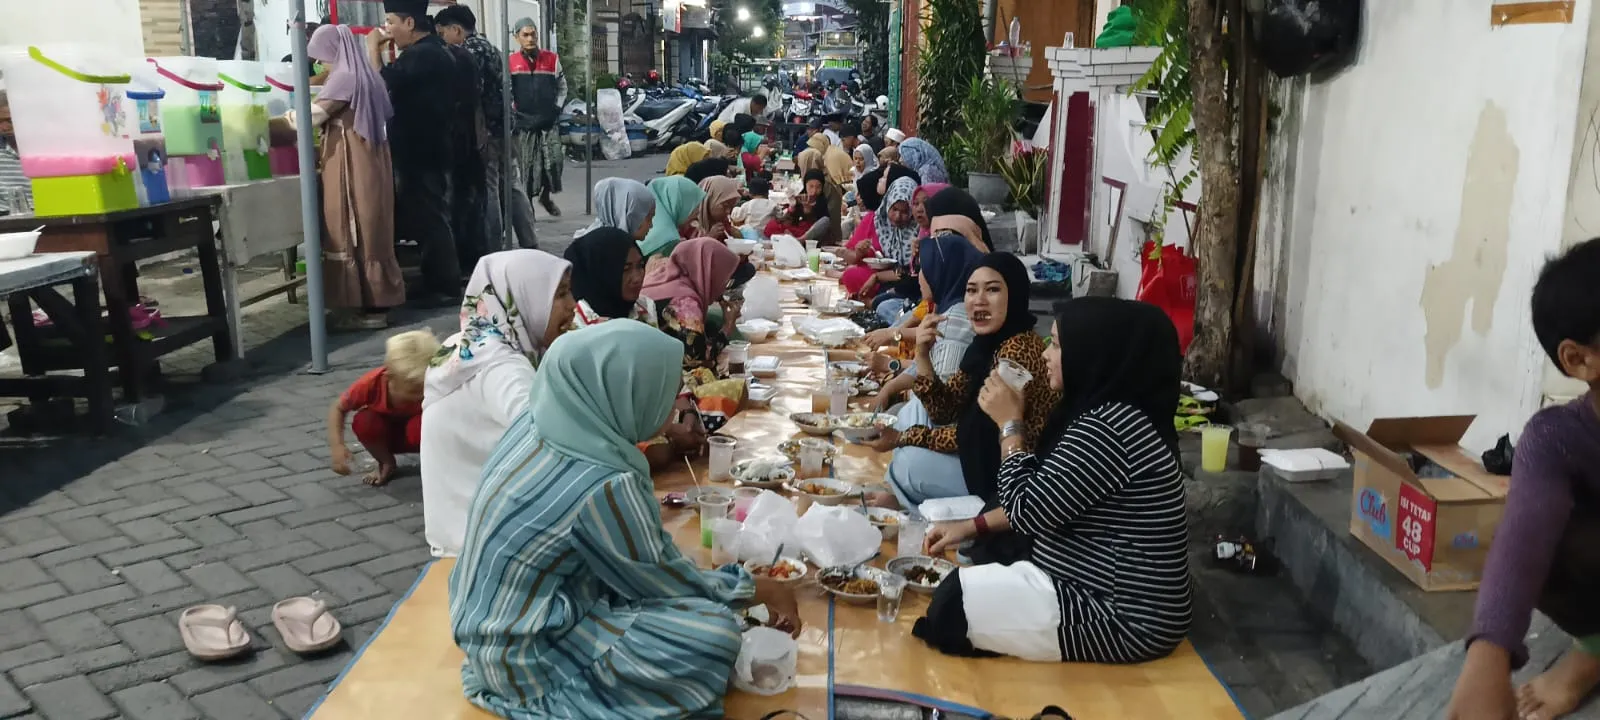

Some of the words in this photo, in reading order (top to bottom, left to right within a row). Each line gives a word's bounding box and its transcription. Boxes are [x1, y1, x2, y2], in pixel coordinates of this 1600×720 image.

[1360, 490, 1386, 524] Club
[1400, 496, 1411, 510] ISI
[1411, 502, 1432, 522] TETAP
[1402, 515, 1423, 544] 48
[1404, 537, 1421, 555] CUP
